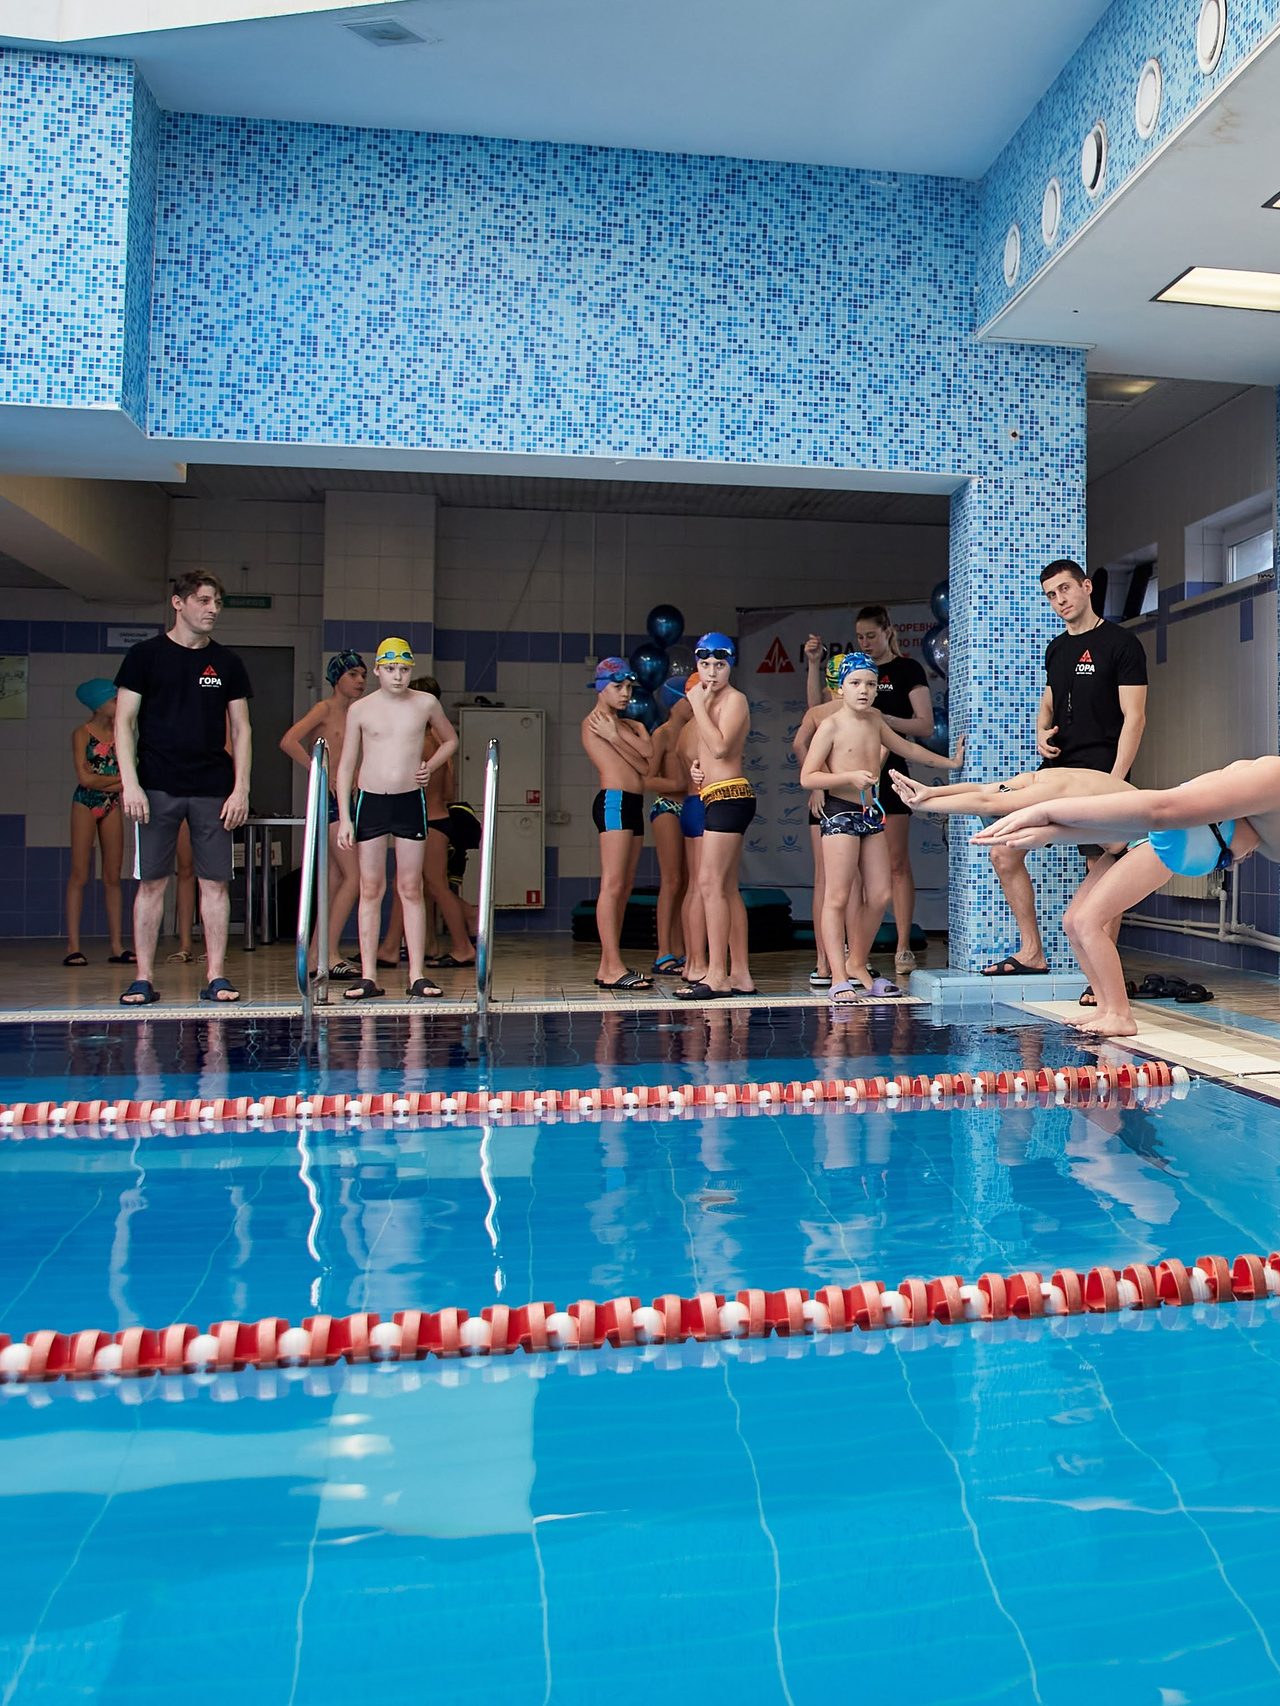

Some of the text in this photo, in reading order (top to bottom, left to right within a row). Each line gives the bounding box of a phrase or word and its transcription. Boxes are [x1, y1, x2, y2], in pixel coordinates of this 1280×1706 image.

[894, 622, 937, 633] СОРЕВН
[1075, 664, 1095, 672] ГОРА
[199, 677, 222, 686] ГОРА
